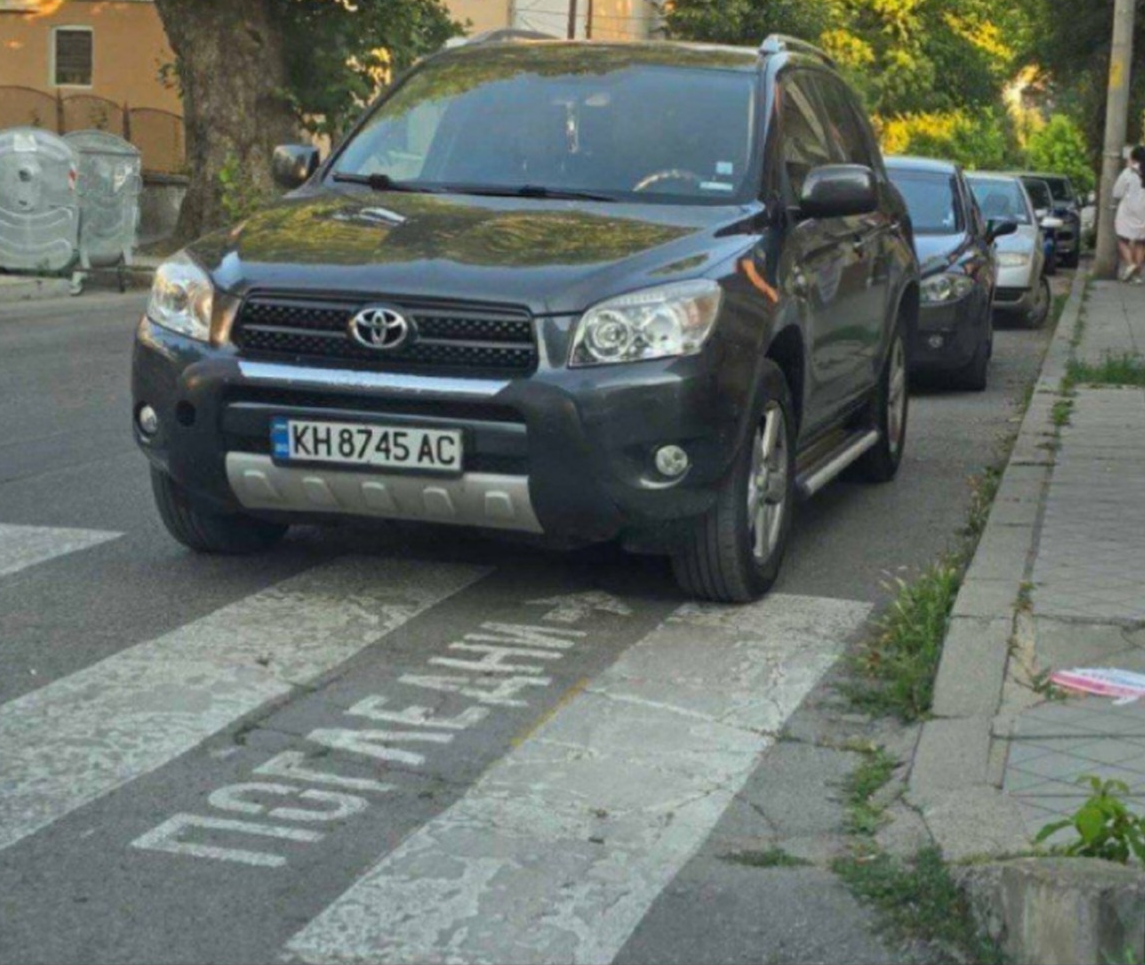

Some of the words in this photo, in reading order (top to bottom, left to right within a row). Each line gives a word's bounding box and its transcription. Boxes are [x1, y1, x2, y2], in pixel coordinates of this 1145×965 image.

[292, 425, 332, 456] KH
[338, 428, 410, 461] 8745
[417, 433, 455, 465] AC
[130, 620, 588, 868] ПОГЛЕДНИ
